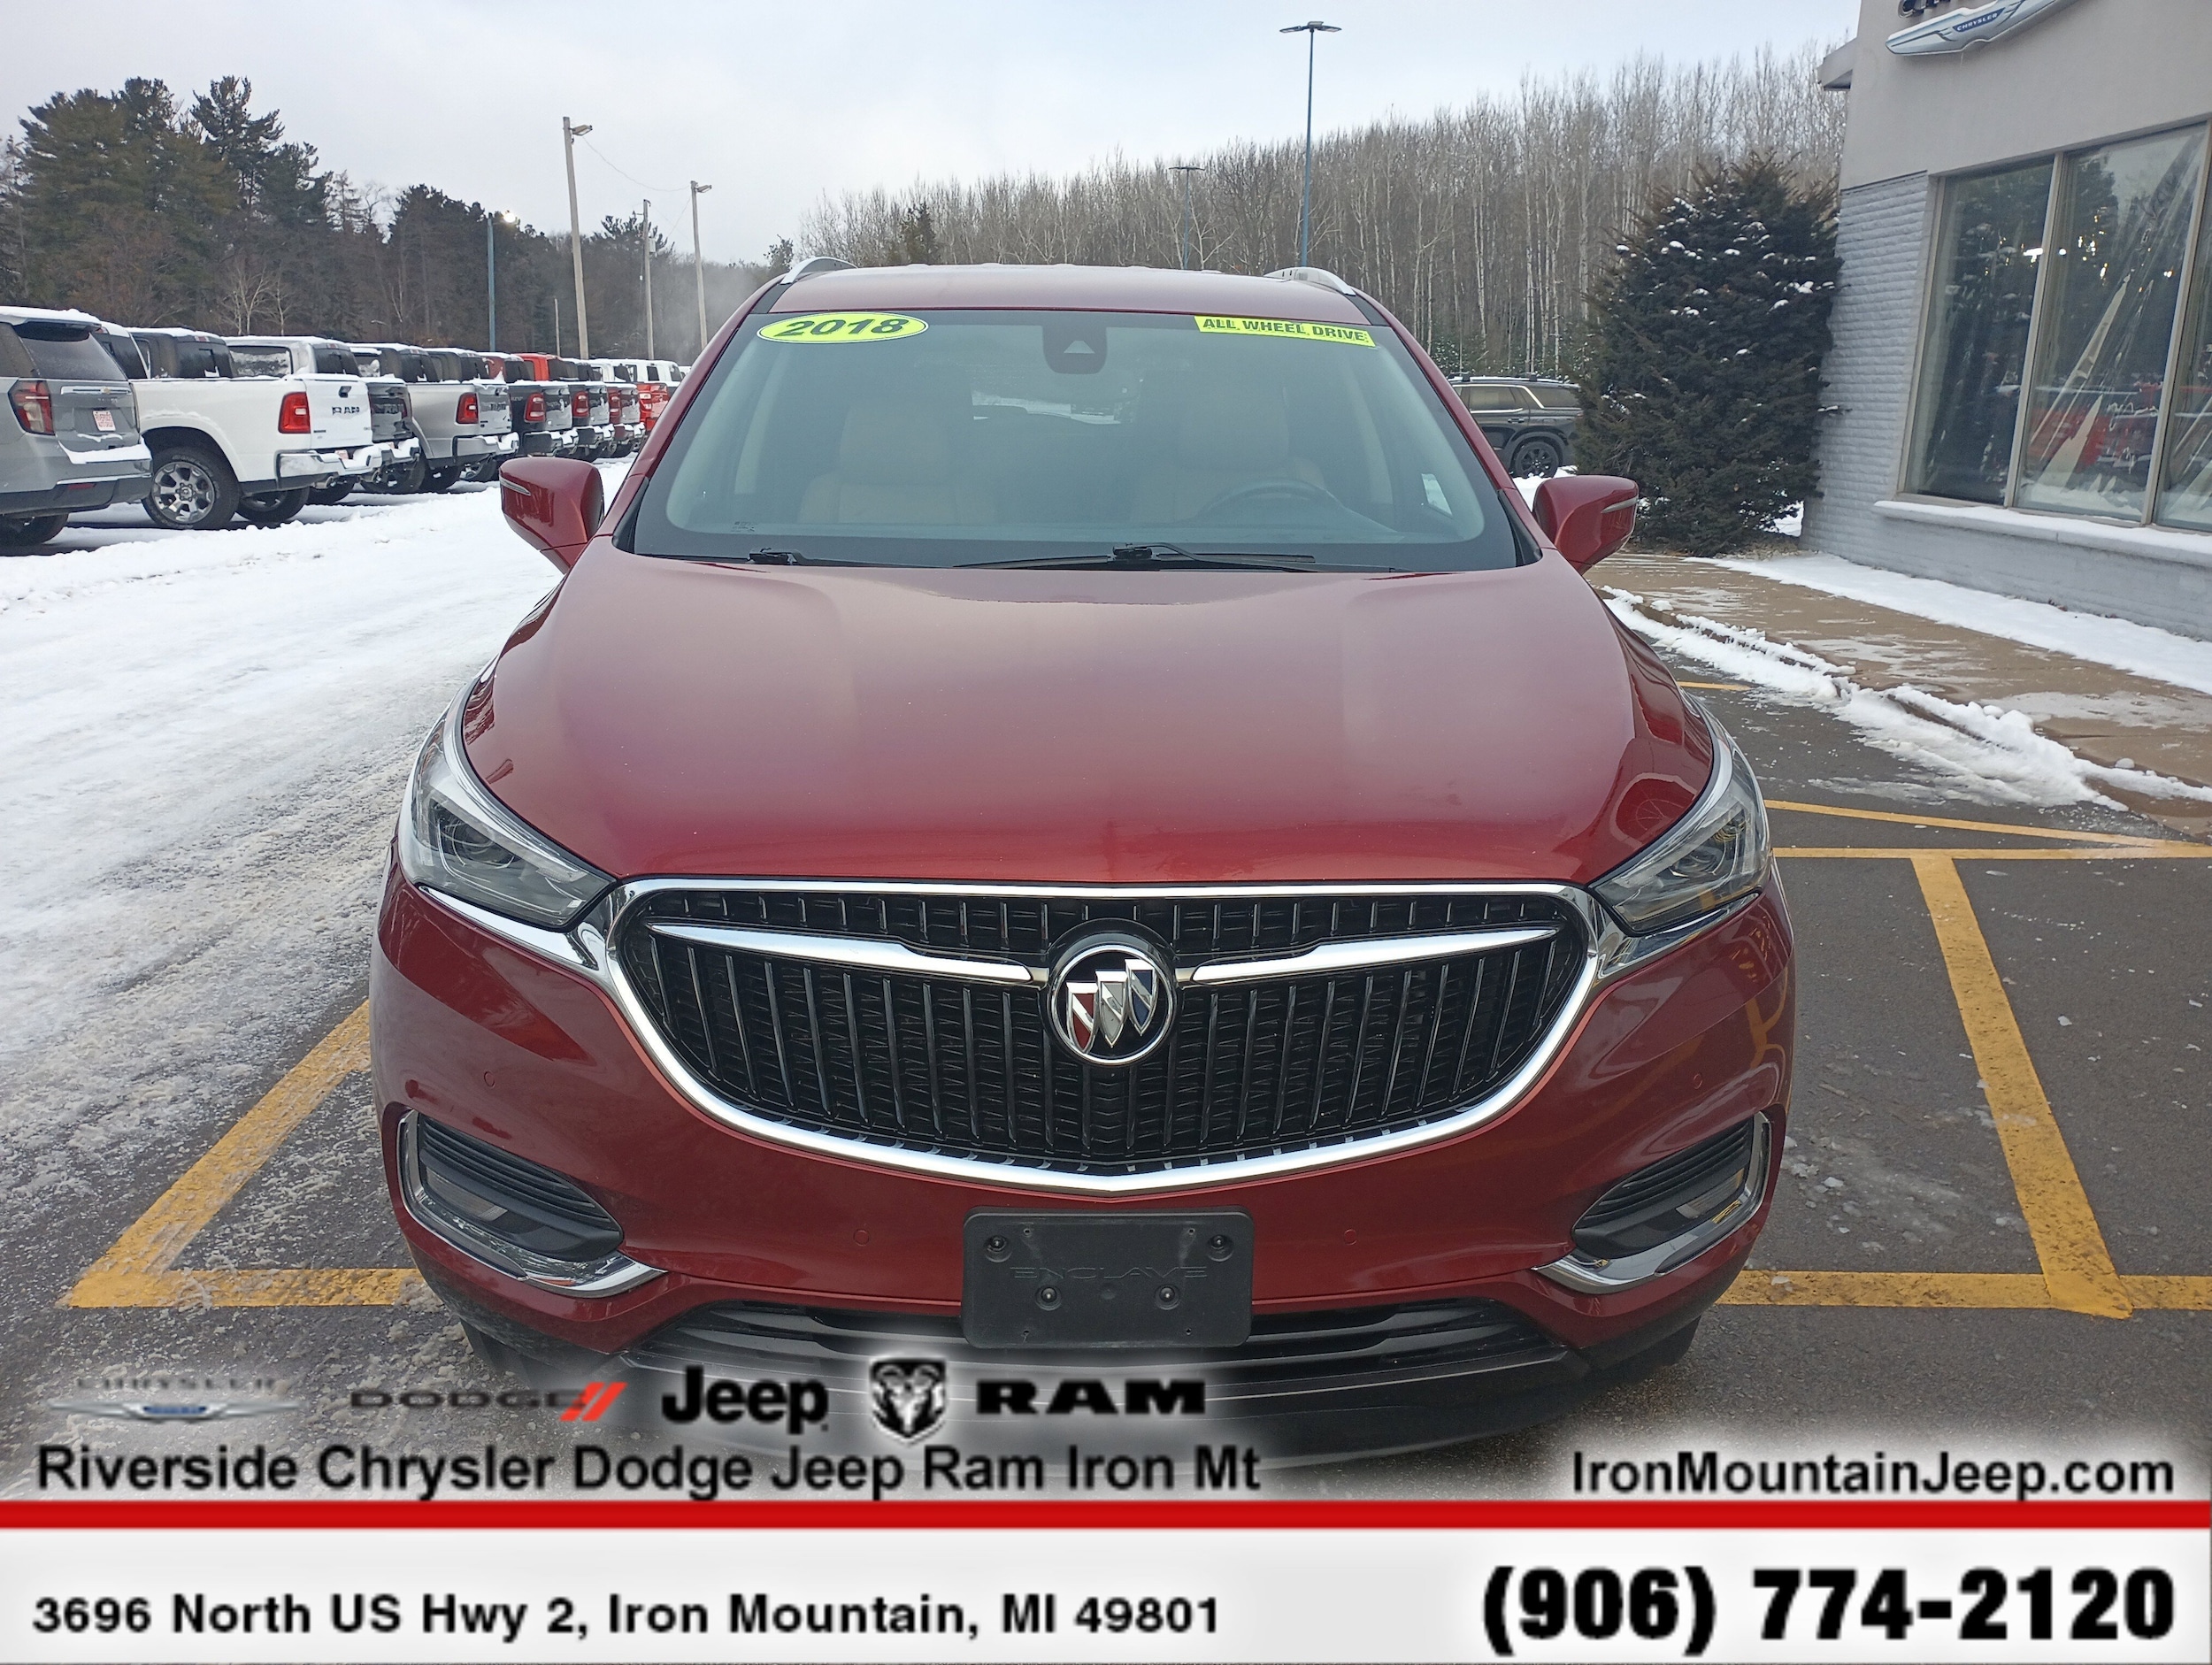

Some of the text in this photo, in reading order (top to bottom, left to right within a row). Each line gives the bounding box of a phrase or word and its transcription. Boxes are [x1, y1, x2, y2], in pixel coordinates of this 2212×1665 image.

[1956, 12, 1998, 32] CHRYSLER
[773, 318, 910, 337] 2018
[1202, 318, 1367, 341] ALL WHEEL DRIVE
[1010, 1267, 1208, 1279] ENCLAVE
